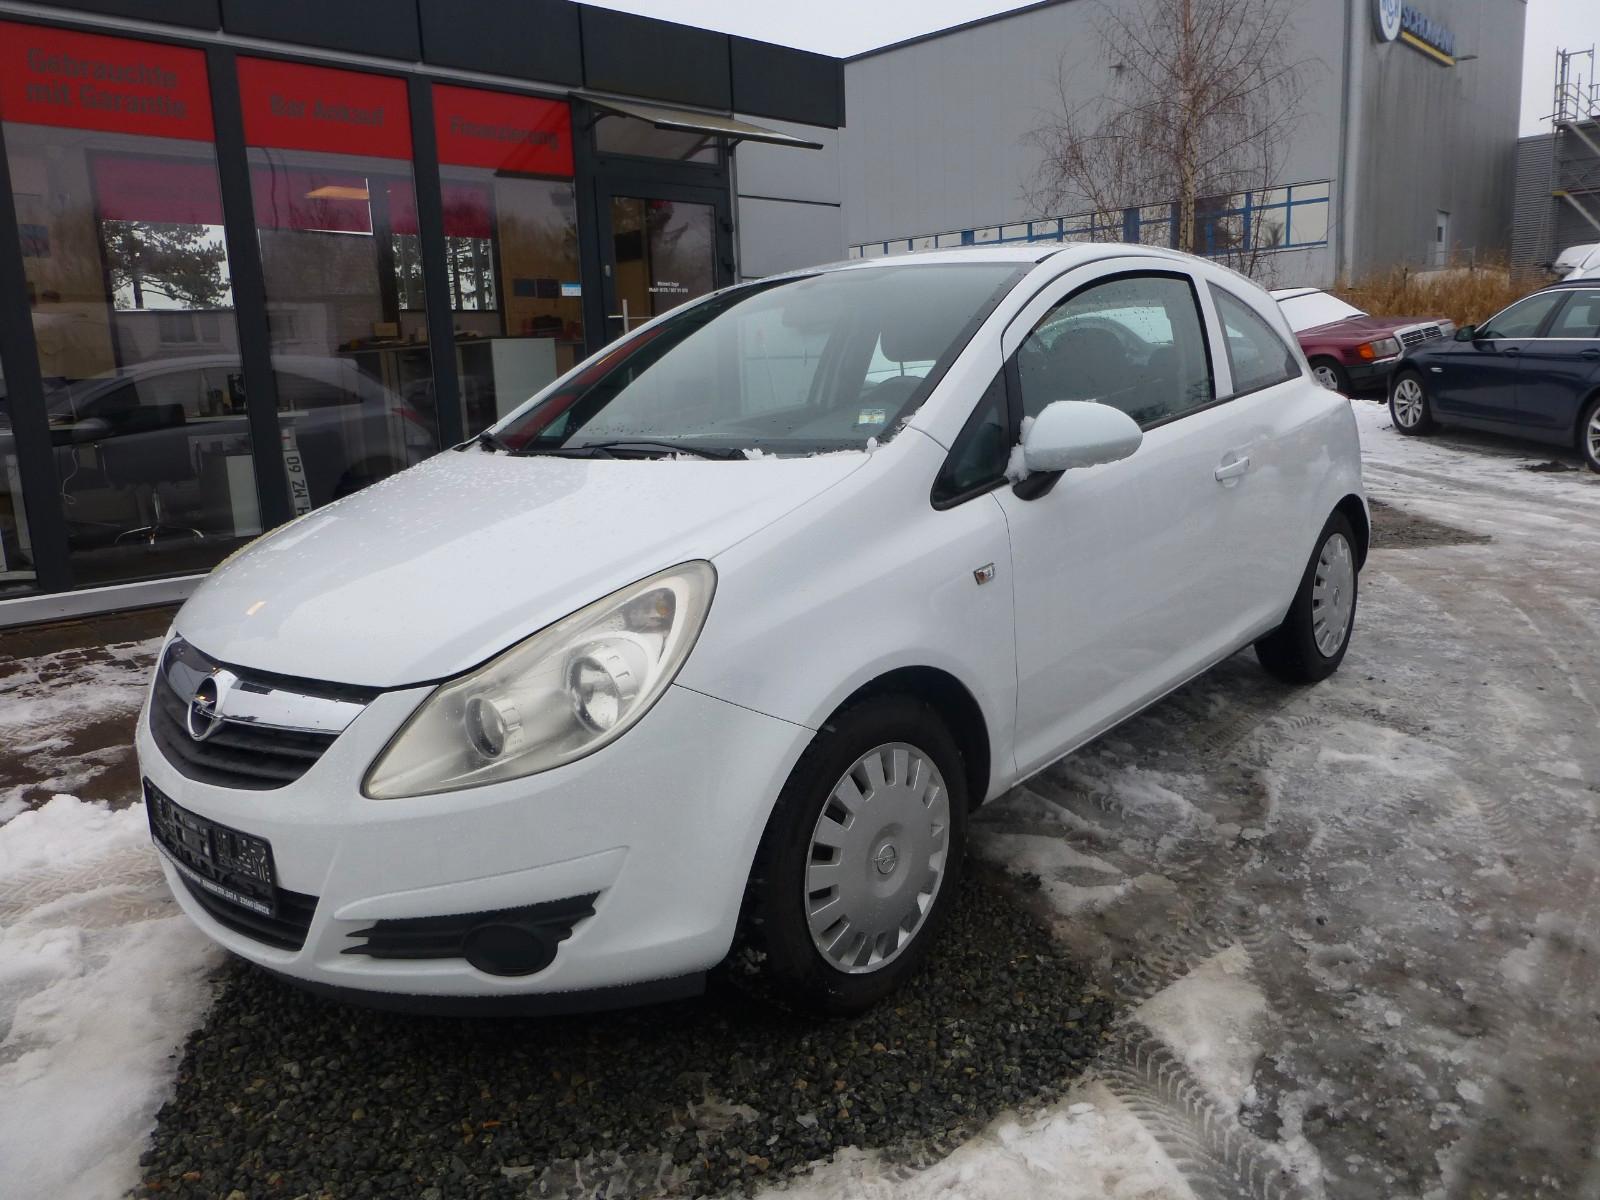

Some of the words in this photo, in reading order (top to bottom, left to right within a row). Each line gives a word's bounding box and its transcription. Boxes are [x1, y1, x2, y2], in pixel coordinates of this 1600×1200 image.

[28, 48, 177, 88] Gebrauchte
[27, 78, 70, 106] mit
[80, 86, 187, 119] Garantie
[312, 98, 385, 128] Ankauf
[449, 115, 560, 152] Finanzierung
[287, 456, 301, 472] 60
